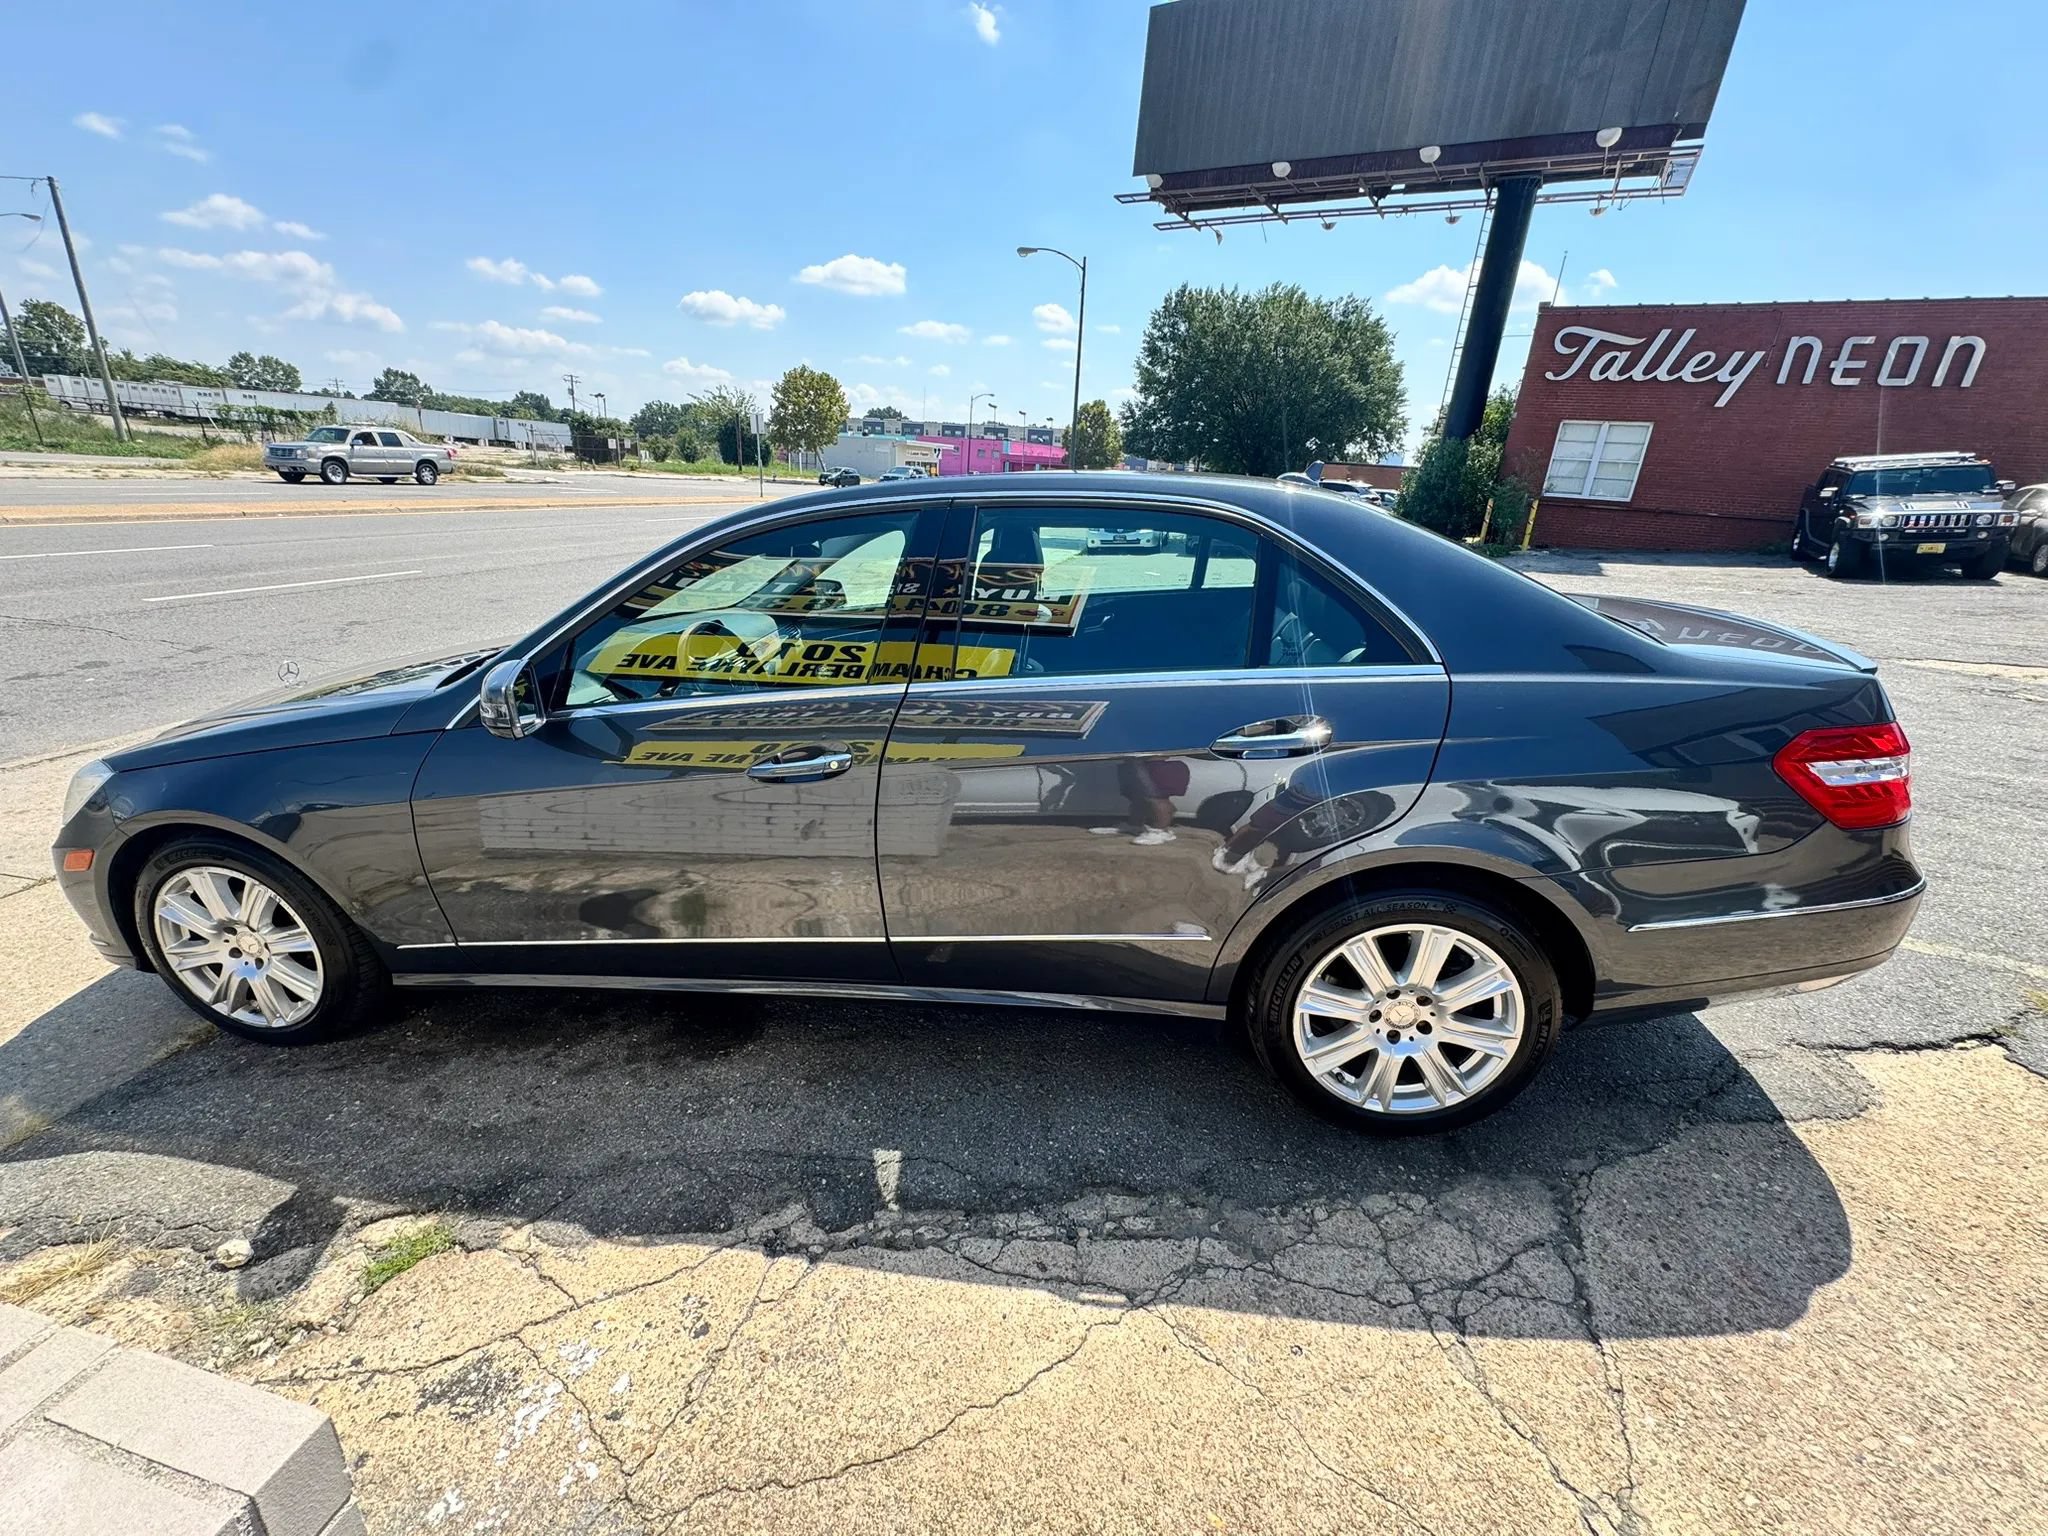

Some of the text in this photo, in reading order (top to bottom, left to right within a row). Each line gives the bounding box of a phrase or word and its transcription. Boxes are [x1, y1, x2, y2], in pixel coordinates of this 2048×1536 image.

[1544, 325, 1987, 408] Talley NEON
[1269, 956, 1301, 1024] MICHELIN
[1364, 905, 1382, 920] ALL
[1386, 901, 1430, 912] SEASON
